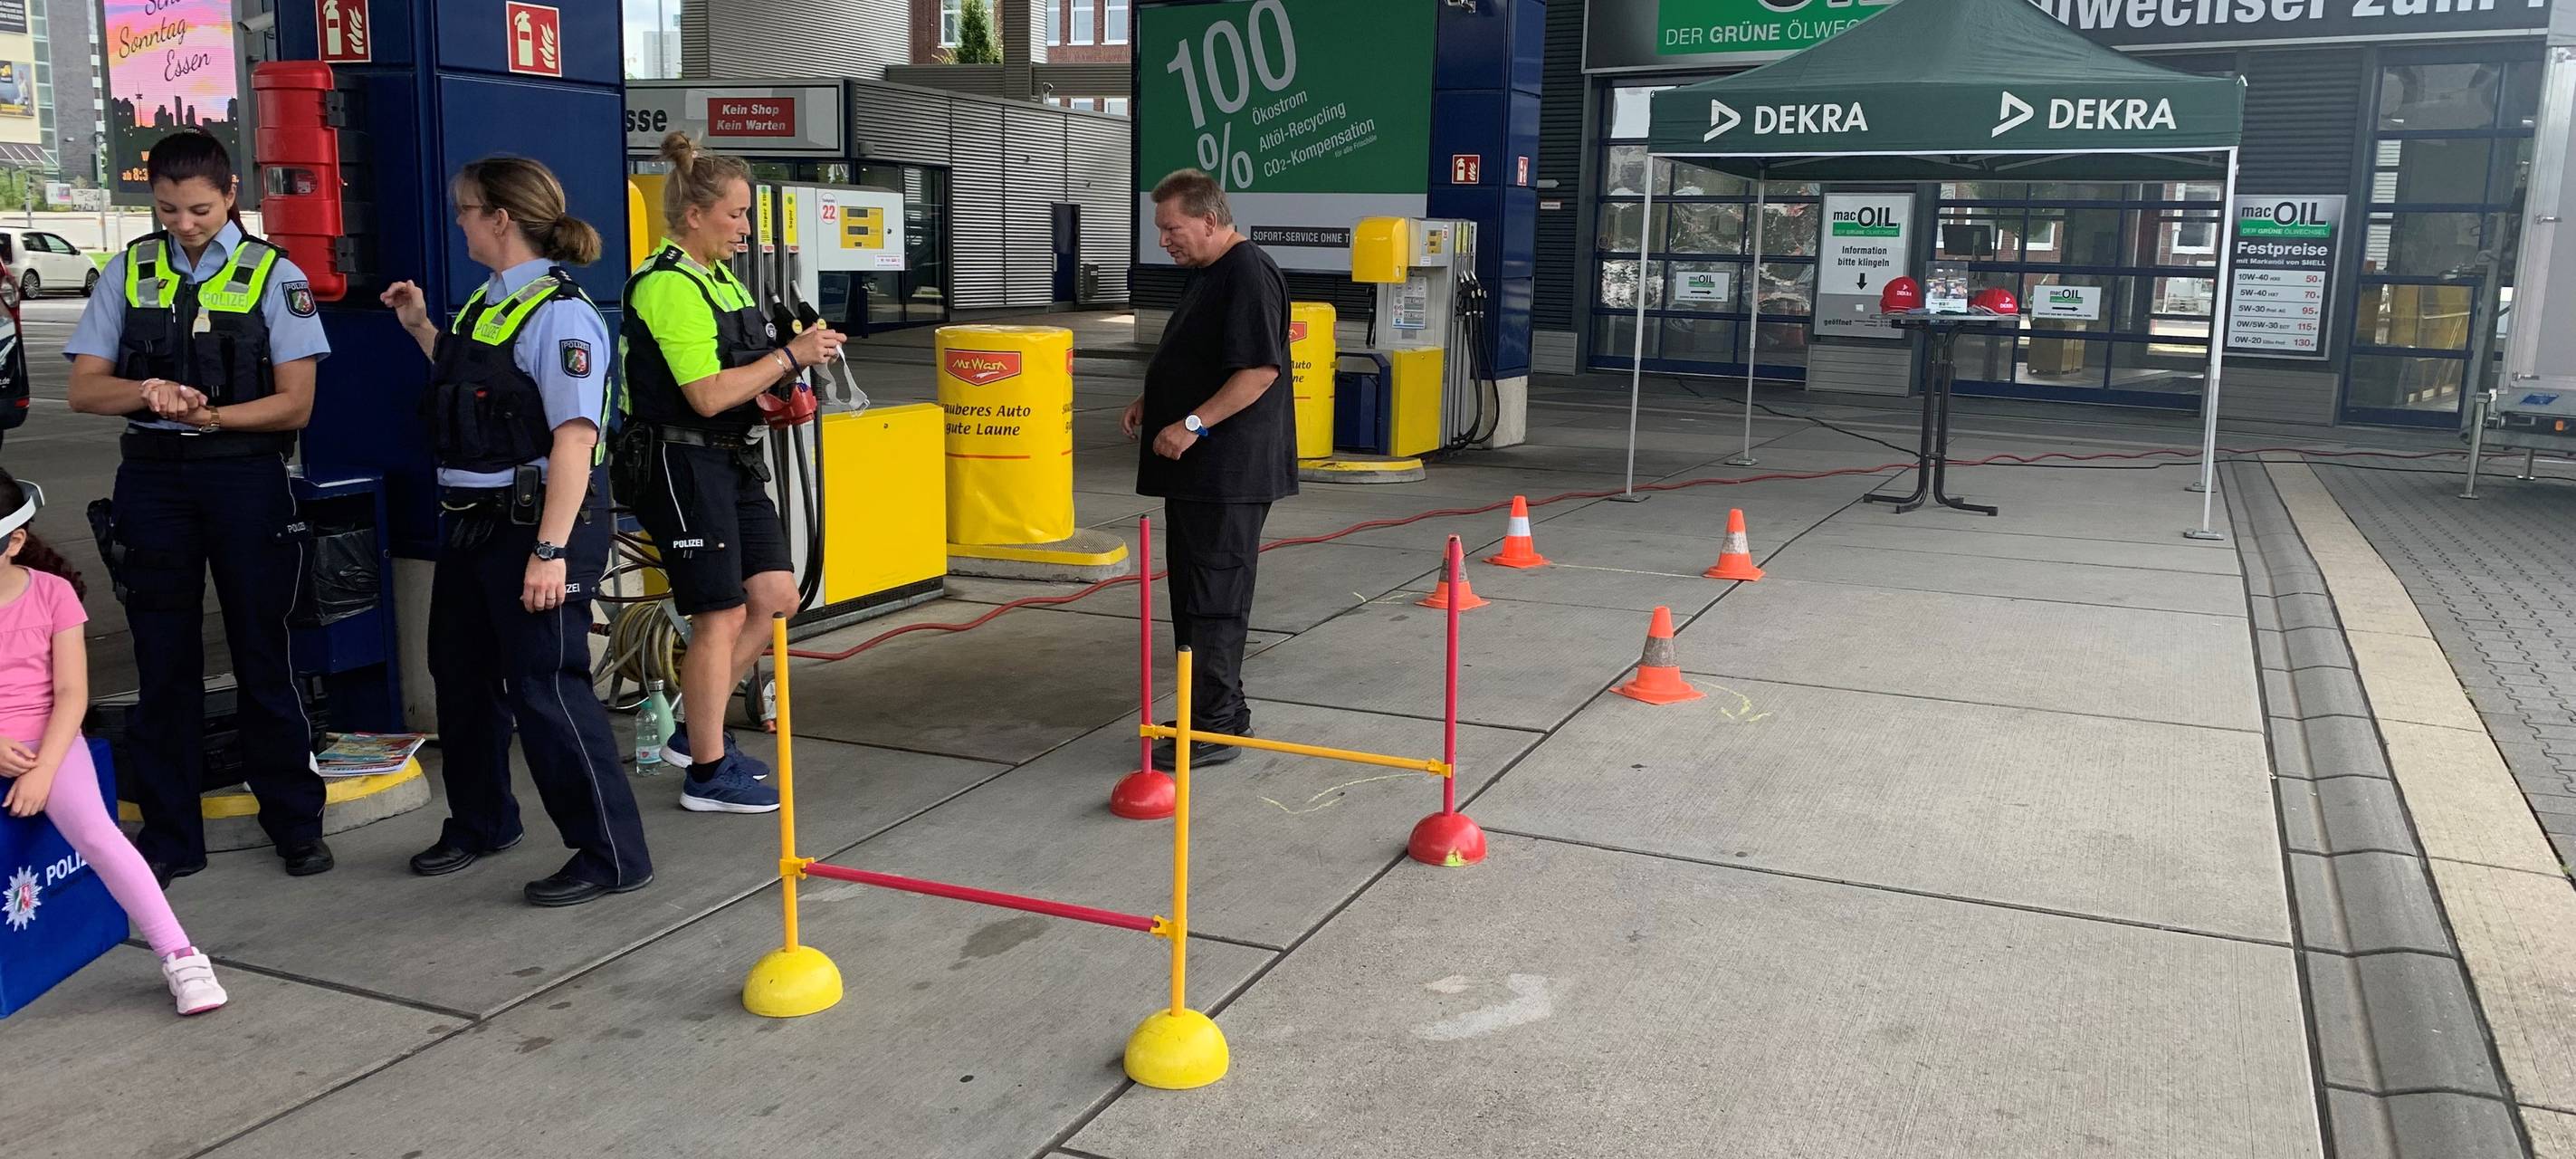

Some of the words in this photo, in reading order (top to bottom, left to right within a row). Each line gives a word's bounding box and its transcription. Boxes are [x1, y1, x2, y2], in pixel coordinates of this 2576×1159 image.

[119, 16, 187, 58] Sonntag
[1665, 28, 1703, 45] DER
[1709, 21, 1780, 43] GRÜNE
[164, 49, 211, 81] Essen
[1167, 0, 1296, 129] 100
[722, 103, 748, 115] Kein
[750, 104, 779, 117] Shop
[1252, 90, 1308, 125] Ökostrom
[2048, 98, 2177, 129] DEKRA
[1754, 101, 1869, 134] DEKRA
[716, 120, 741, 131] Kein
[746, 120, 786, 131] Warten
[1259, 101, 1347, 153] Altöl-Recycling
[1197, 121, 1254, 192] %
[823, 205, 835, 219] 22
[1253, 230, 1319, 242] SOFORT-SERVICE
[1321, 233, 1342, 243] OHNE
[2257, 226, 2283, 235] GRÜNE
[2284, 226, 2326, 235] ÖLWECHSEL
[1842, 245, 1887, 254] Information
[2237, 241, 2328, 257] Festpreise
[1837, 257, 1856, 266] bitte
[1858, 257, 1890, 268] klingeln
[2238, 273, 2268, 282] 10W-40
[2305, 274, 2318, 283] 50
[2240, 289, 2266, 297] 5W-40
[2304, 291, 2316, 299] 70
[2238, 304, 2265, 312] 5W-30
[2302, 306, 2314, 315] 95
[1823, 318, 1853, 327] geöffnet
[2237, 320, 2278, 329] 0W/5W-30
[2297, 322, 2313, 330] 115
[2235, 336, 2262, 344] 0W-20
[2295, 339, 2311, 347] 130
[997, 404, 1031, 417] Auto
[946, 422, 971, 436] gute
[976, 423, 1020, 436] Laune
[673, 539, 703, 549] POLIZEI
